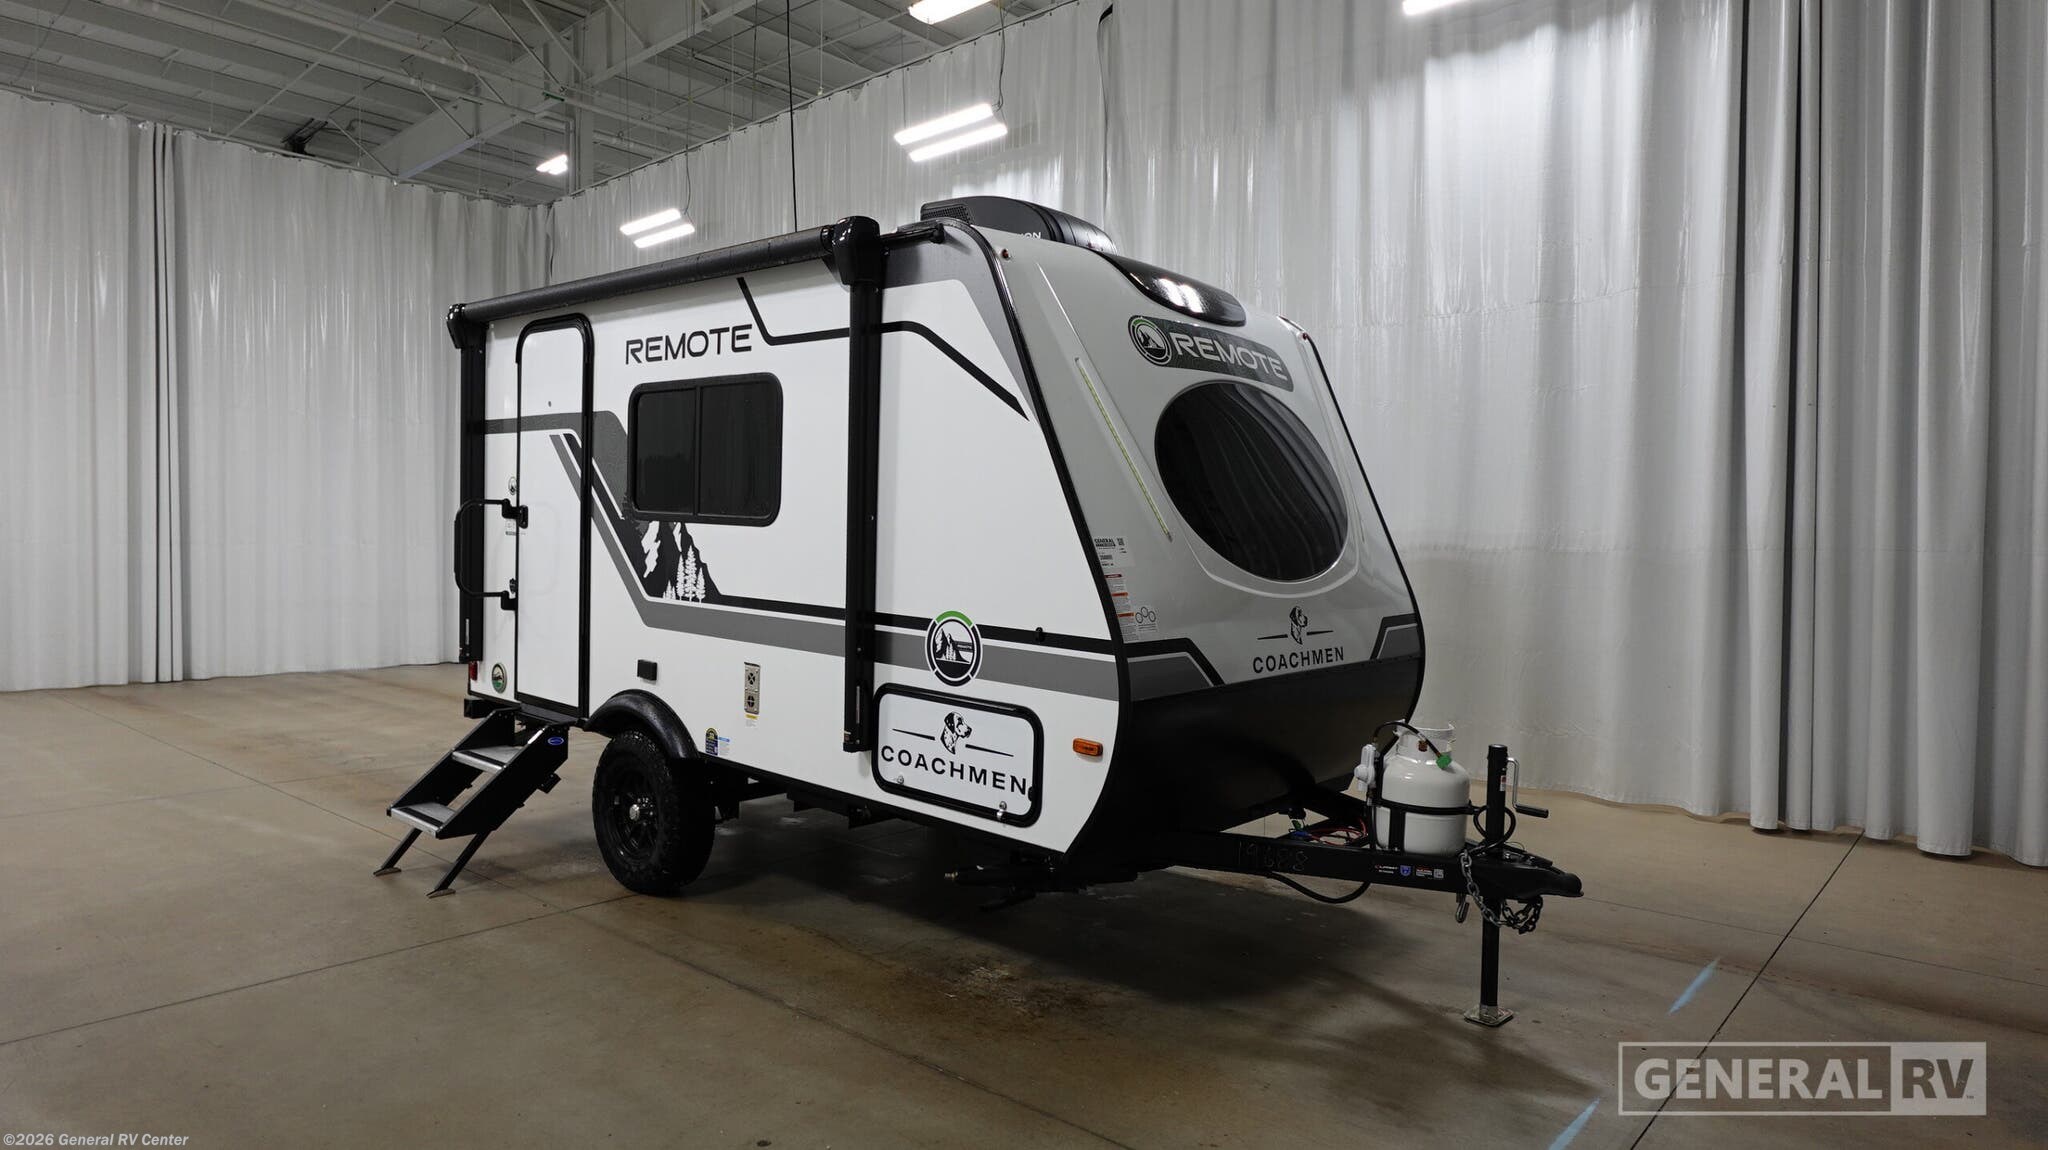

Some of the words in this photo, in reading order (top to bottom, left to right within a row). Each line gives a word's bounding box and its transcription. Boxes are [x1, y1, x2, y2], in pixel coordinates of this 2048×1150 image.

[625, 323, 753, 365] REMOTE
[1169, 331, 1288, 381] REMOTE
[1252, 646, 1345, 674] COACHMEN
[880, 745, 1027, 796] COACHMEN
